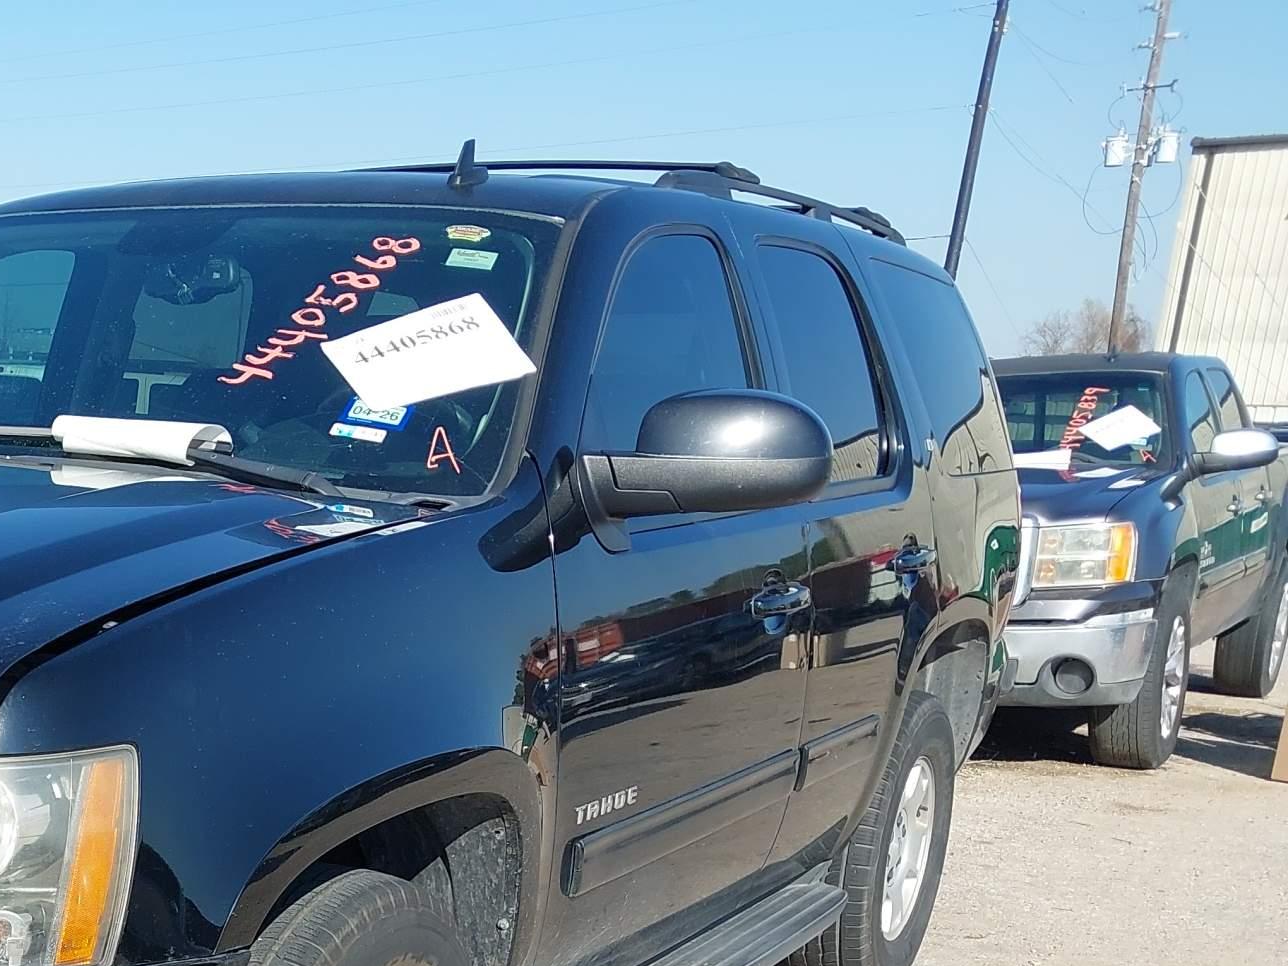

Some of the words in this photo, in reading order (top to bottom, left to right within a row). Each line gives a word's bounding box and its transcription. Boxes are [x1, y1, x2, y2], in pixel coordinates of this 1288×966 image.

[217, 237, 421, 384] 44405868
[355, 316, 481, 365] 44405868
[427, 426, 461, 474] A
[575, 785, 639, 825] TAHOE
